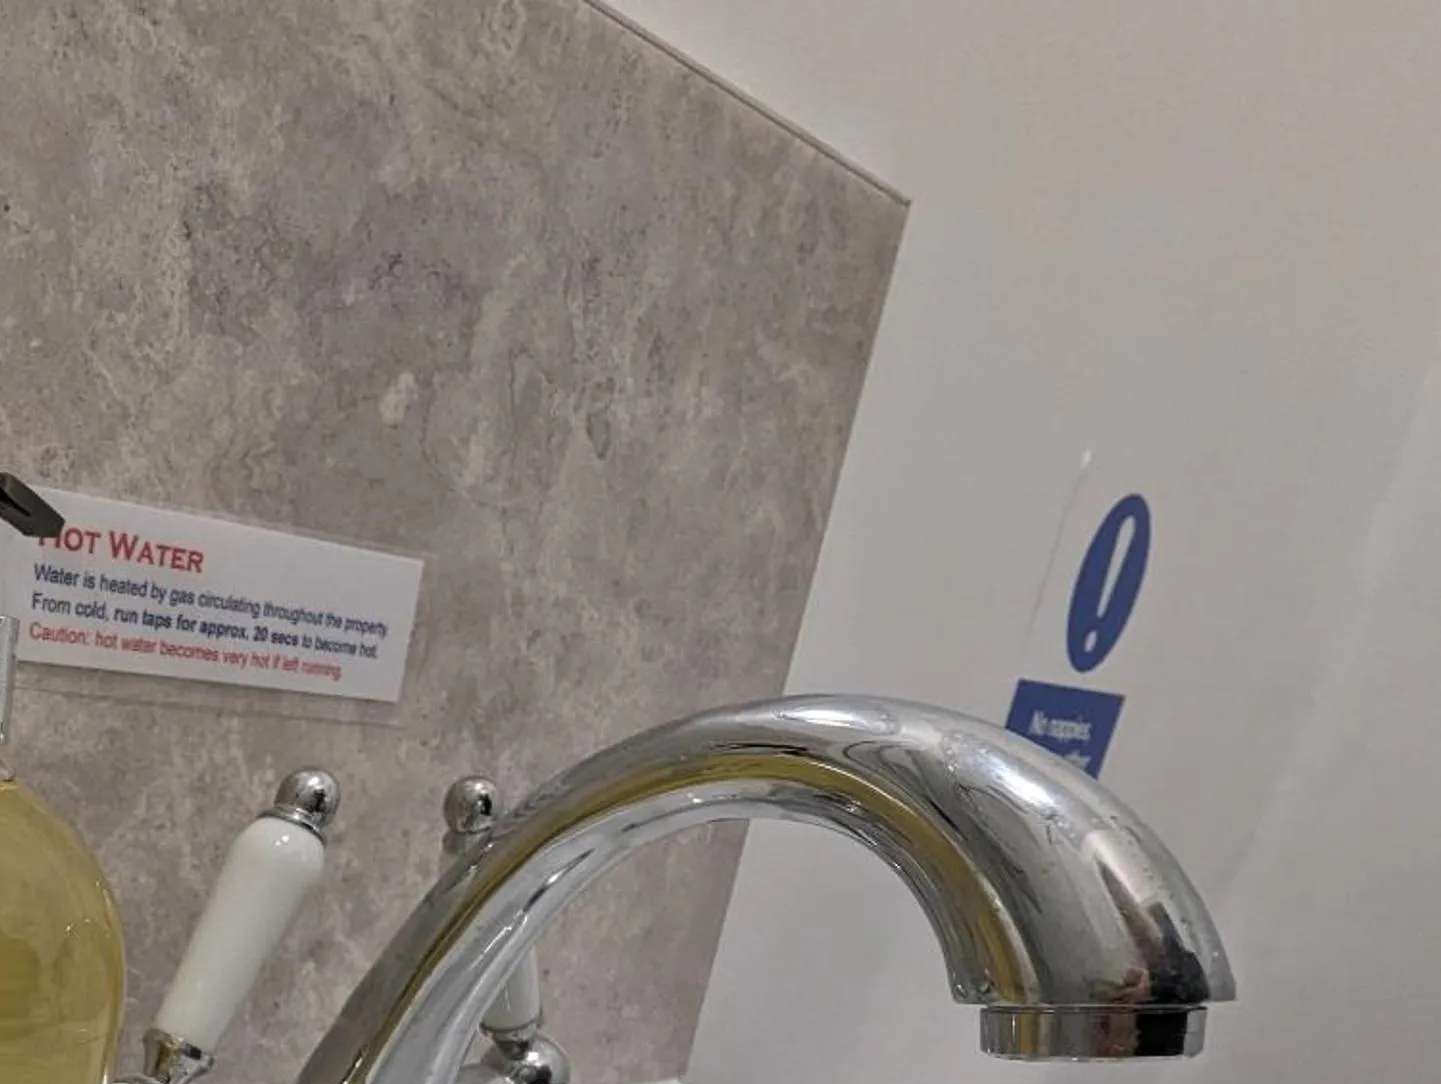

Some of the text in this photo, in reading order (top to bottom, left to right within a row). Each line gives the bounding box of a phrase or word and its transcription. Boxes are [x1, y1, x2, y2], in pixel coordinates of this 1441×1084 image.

[109, 529, 205, 574] WATER
[31, 591, 70, 616] From
[74, 602, 109, 622] cold,
[113, 606, 138, 625] run
[142, 608, 172, 631] taps
[176, 613, 197, 632] for
[200, 619, 249, 641] approx.
[253, 624, 268, 642] 20
[271, 631, 299, 647] secs
[301, 633, 313, 648] to
[314, 635, 357, 656] become
[34, 563, 79, 588] Water
[83, 572, 96, 590] is
[100, 573, 148, 598] heated
[150, 585, 167, 606] by
[169, 589, 194, 607] gas
[198, 590, 260, 619] circulating
[263, 601, 324, 626] throughout
[325, 611, 343, 629] the
[29, 621, 91, 646] Caution:
[95, 630, 117, 647] hot
[121, 635, 157, 655] water
[159, 638, 219, 662] becomes
[222, 648, 247, 670] very
[250, 650, 270, 670] hot
